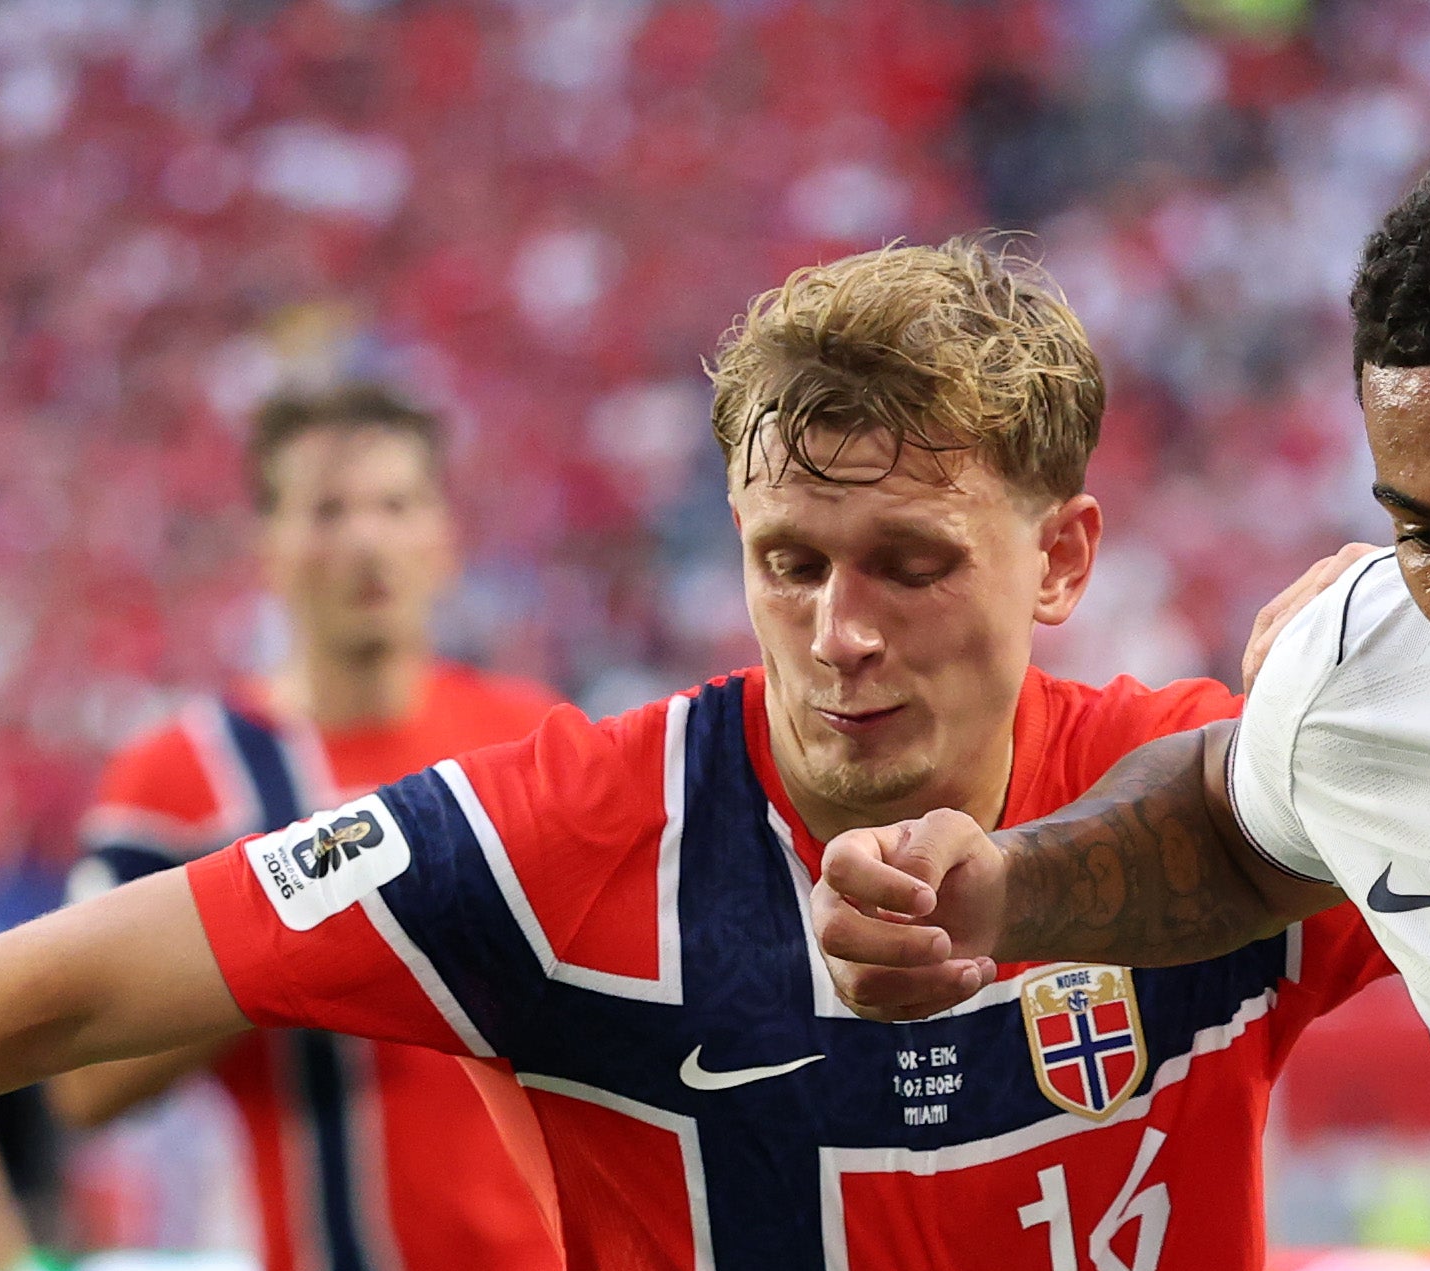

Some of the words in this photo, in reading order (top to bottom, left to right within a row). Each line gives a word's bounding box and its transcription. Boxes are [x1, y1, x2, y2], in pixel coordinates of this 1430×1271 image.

[262, 852, 296, 900] 2026
[1056, 970, 1092, 989] NORGE
[930, 1045, 958, 1067] ENG
[904, 1104, 948, 1126] MIAMI
